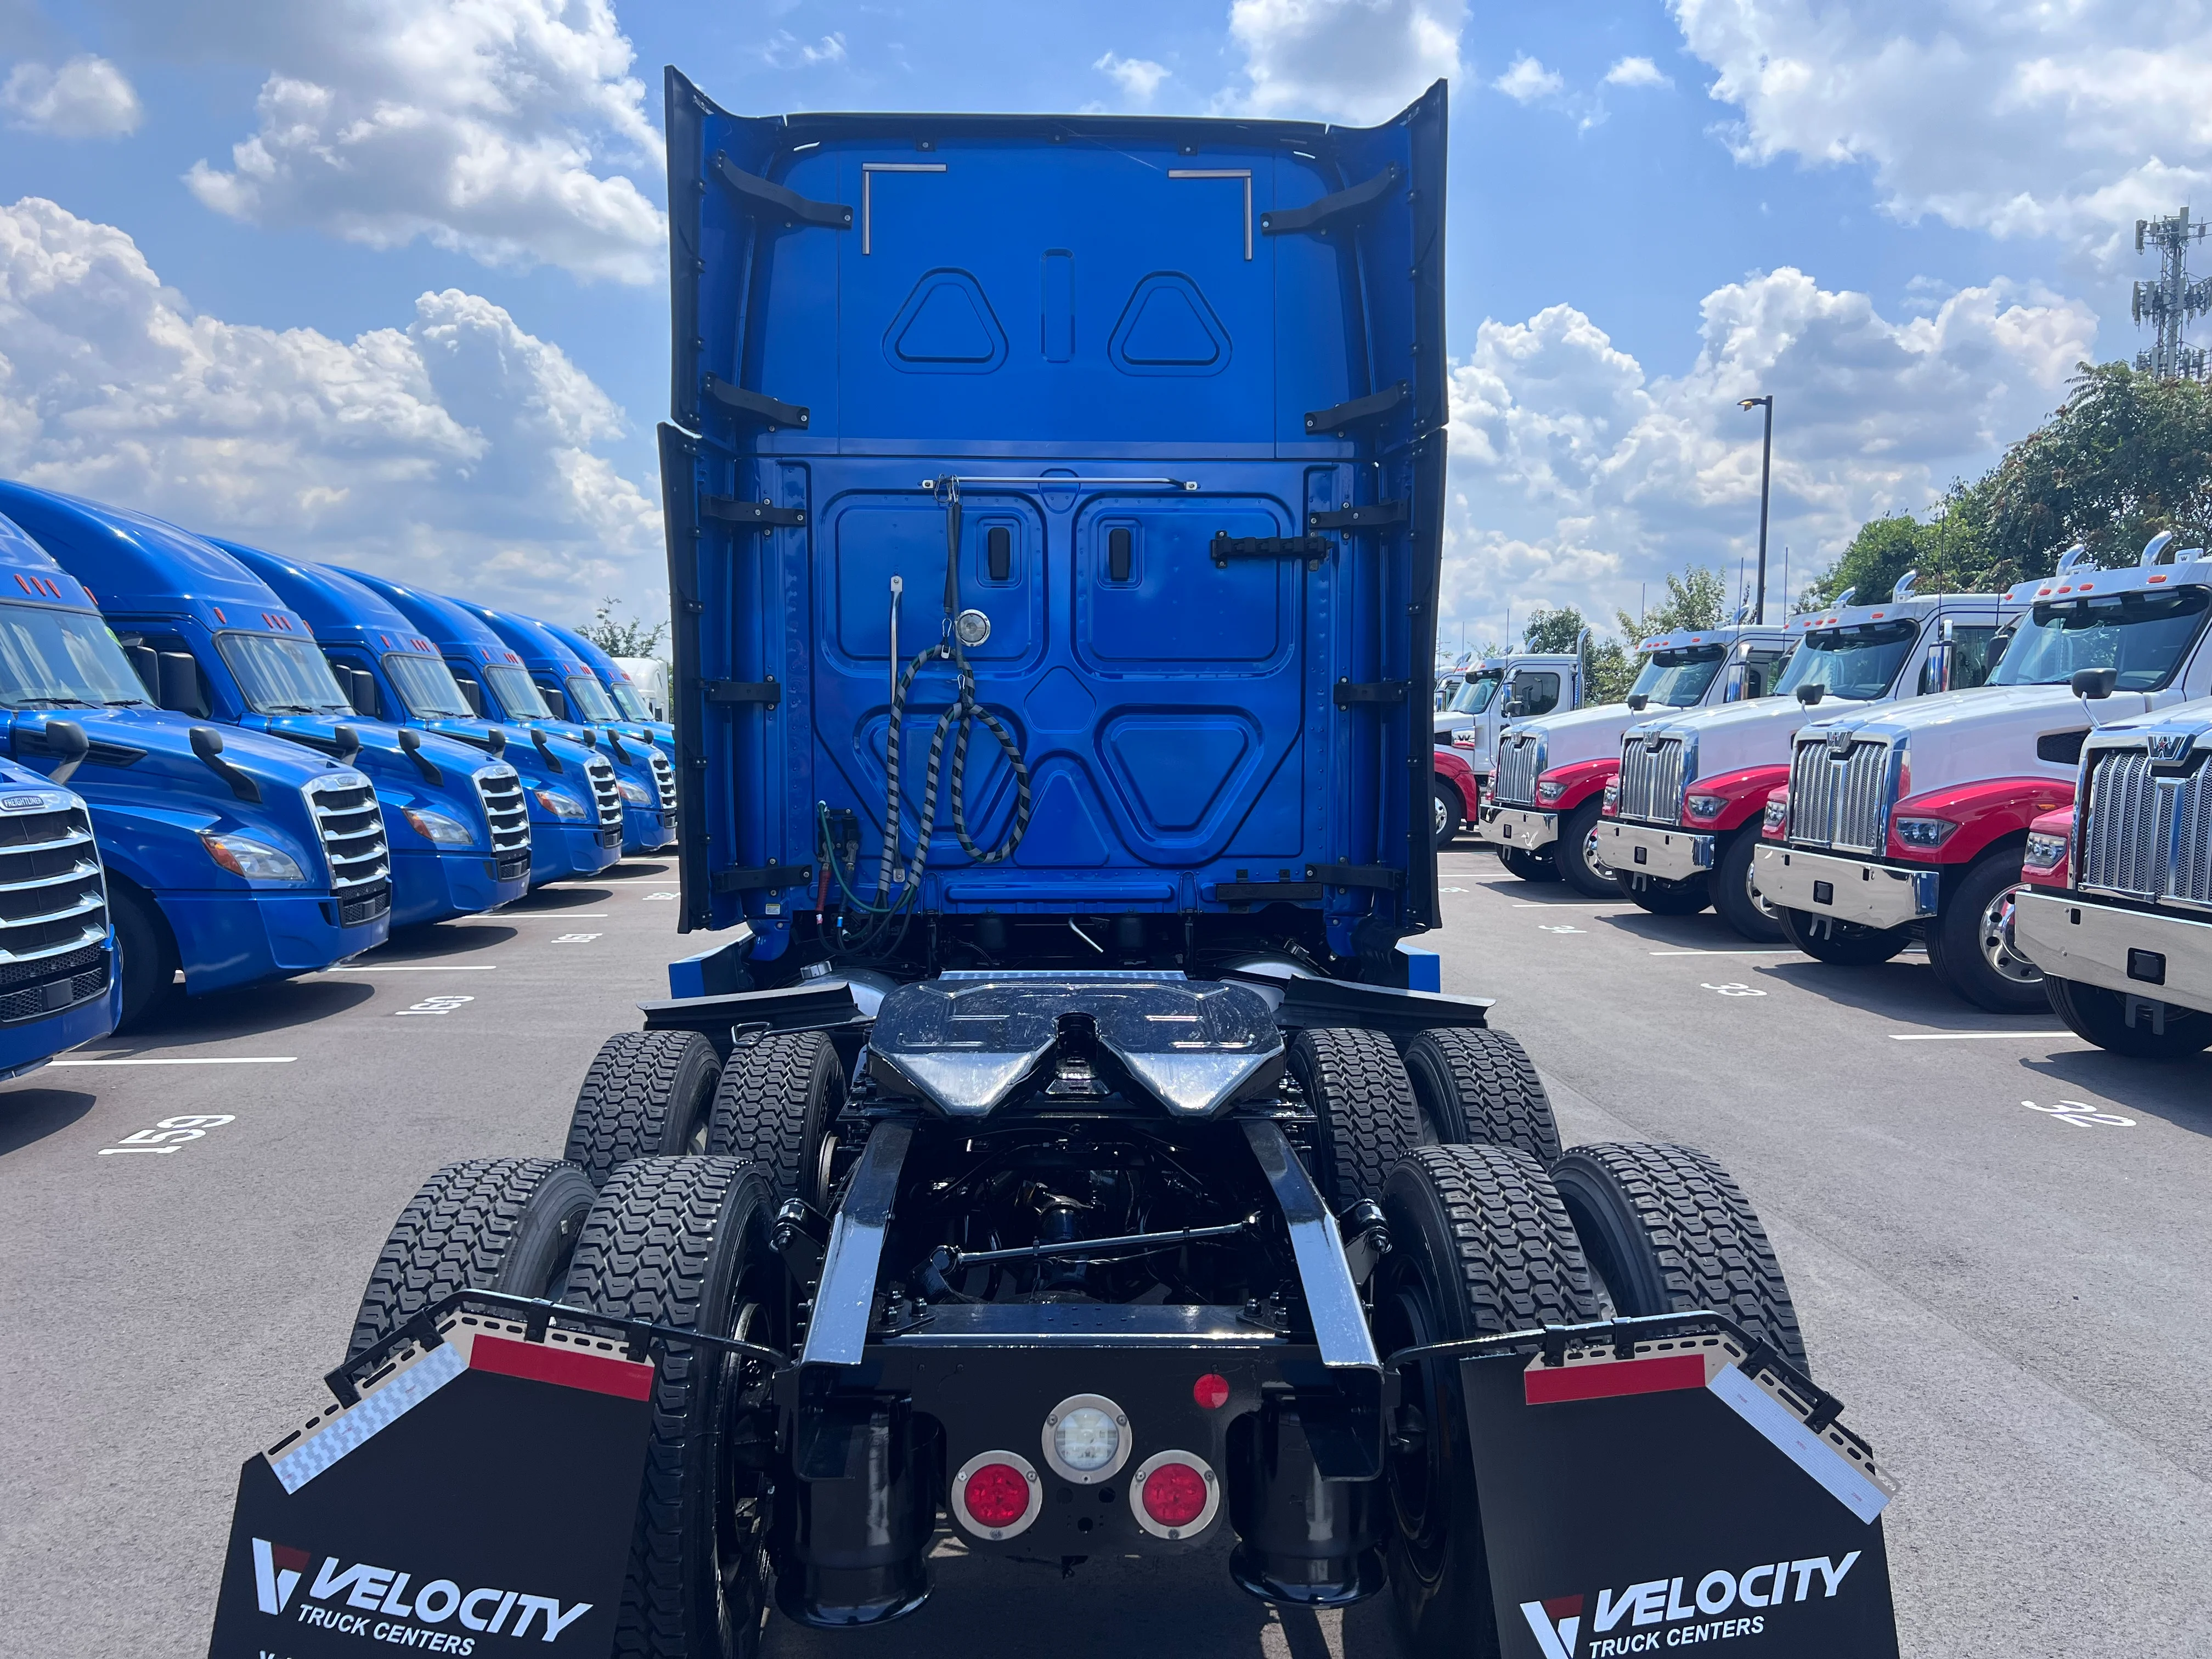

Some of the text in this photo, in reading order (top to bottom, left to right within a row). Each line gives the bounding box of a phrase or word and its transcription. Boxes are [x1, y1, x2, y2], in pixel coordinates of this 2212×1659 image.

[551, 933, 603, 943] 161
[395, 995, 475, 1015] 160
[1700, 983, 1768, 996] 33
[2021, 1099, 2137, 1127] 32
[98, 1114, 236, 1155] 159
[309, 1556, 594, 1642] VELOCITY
[1593, 1550, 1862, 1633] VELOCITY
[298, 1604, 475, 1656] TRUCK CENTERS
[1589, 1616, 1764, 1659] TRUCK CENTERS
